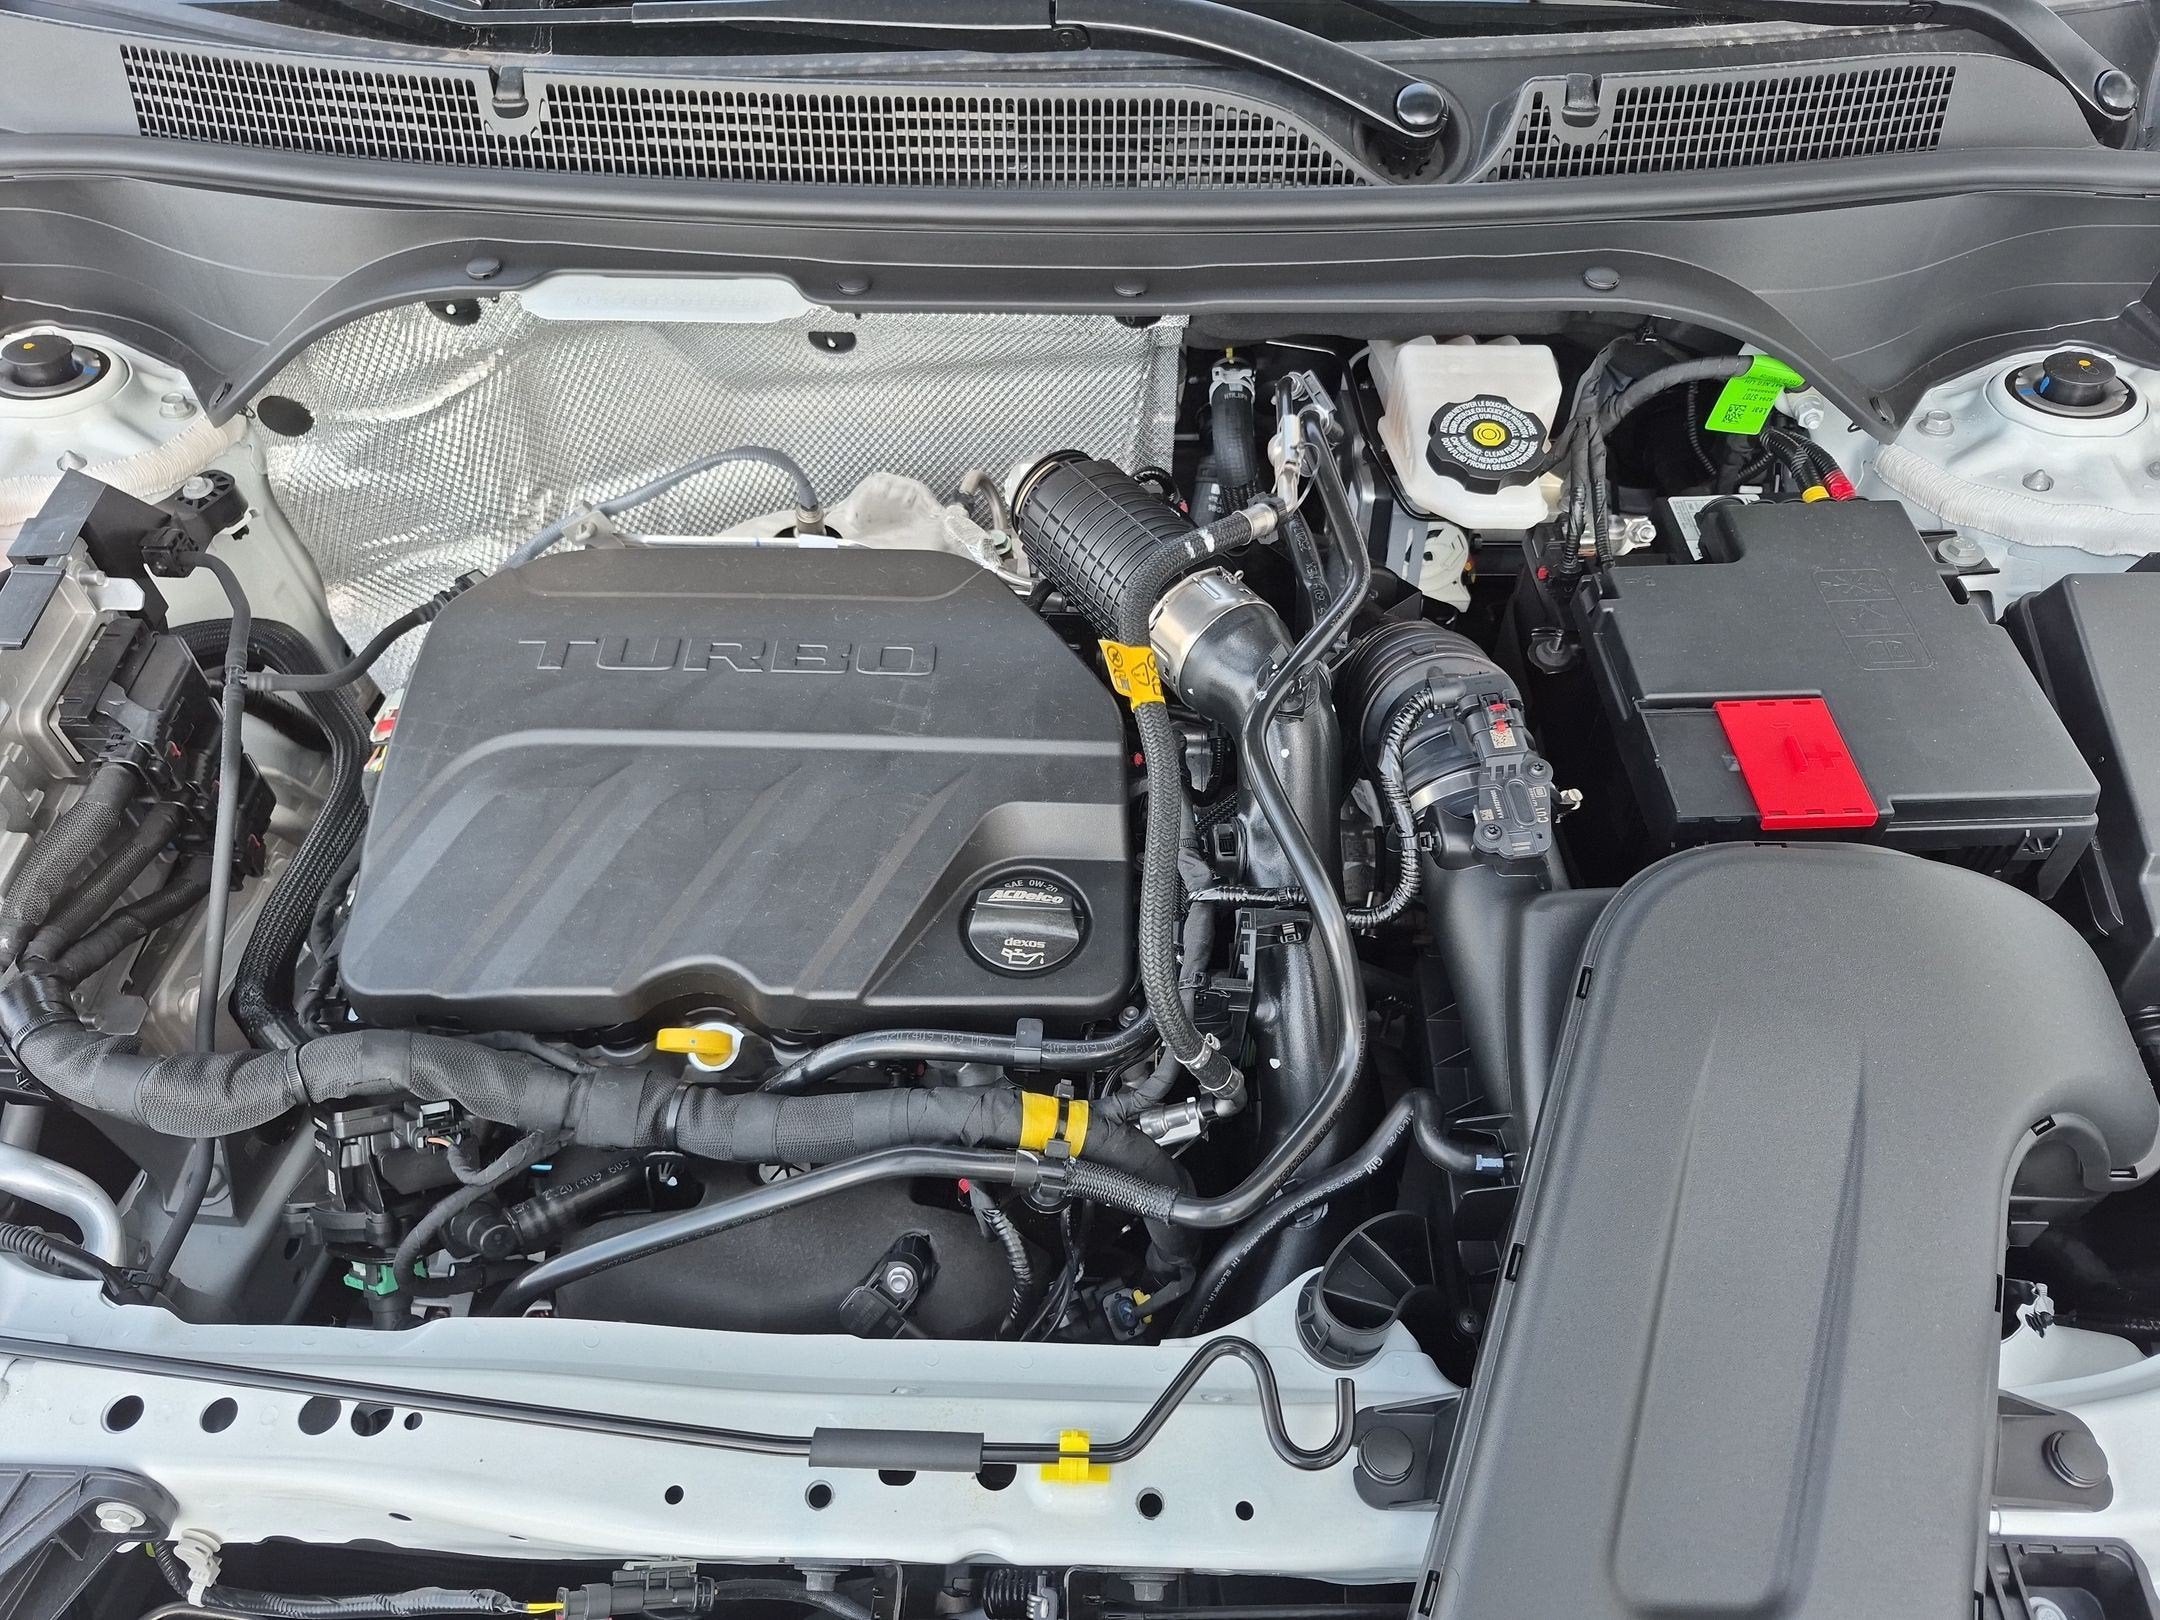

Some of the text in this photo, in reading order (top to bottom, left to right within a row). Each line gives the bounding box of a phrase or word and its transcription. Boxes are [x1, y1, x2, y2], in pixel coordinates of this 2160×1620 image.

[518, 638, 937, 676] TURBO
[1004, 879, 1058, 893] SAE 0W-20
[987, 889, 1064, 904] ACDelco
[1004, 937, 1047, 949] dexos
